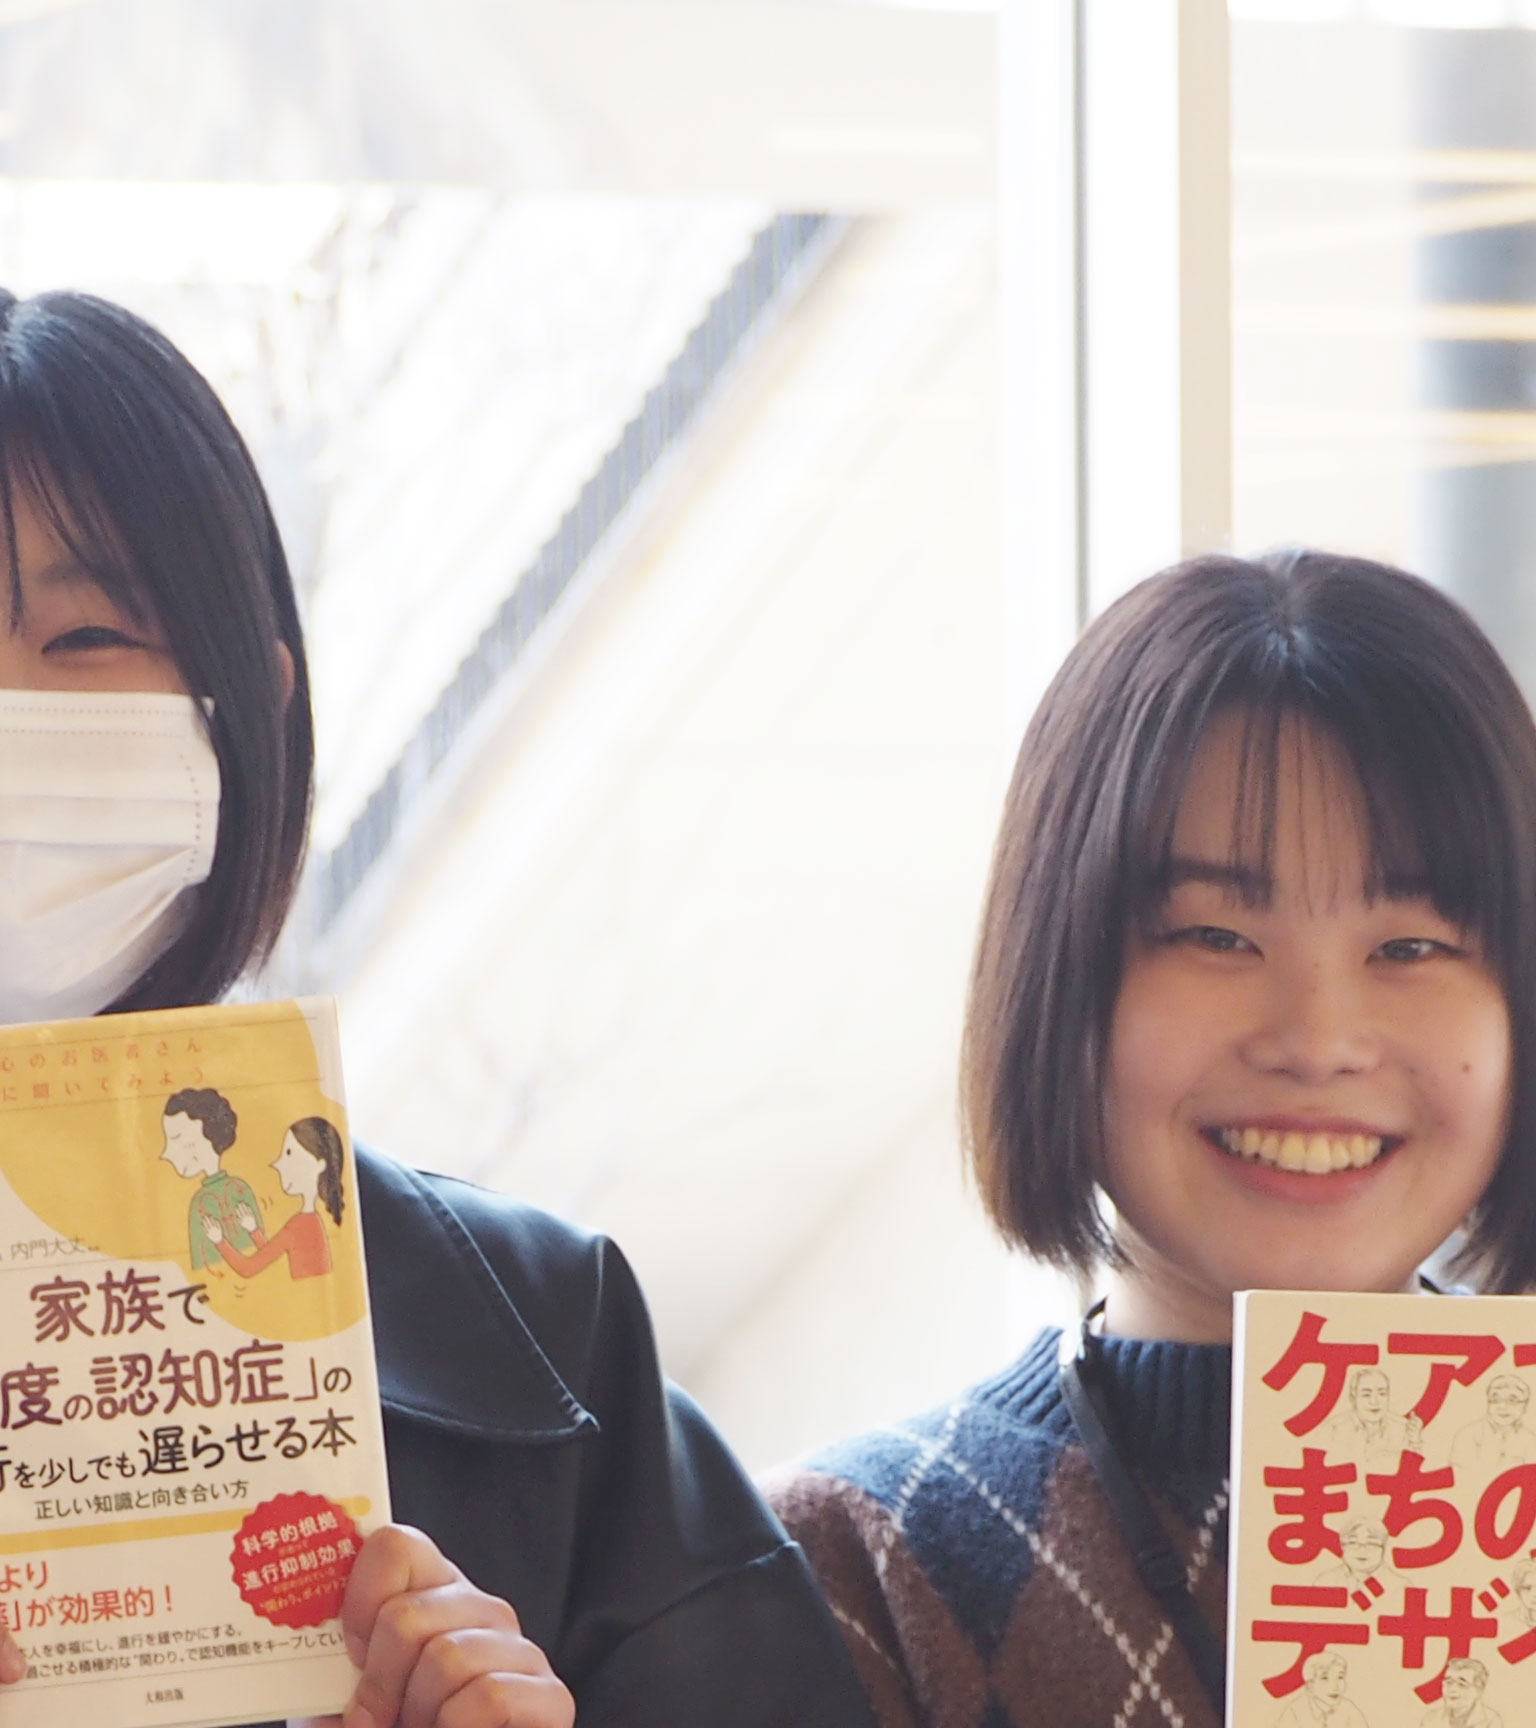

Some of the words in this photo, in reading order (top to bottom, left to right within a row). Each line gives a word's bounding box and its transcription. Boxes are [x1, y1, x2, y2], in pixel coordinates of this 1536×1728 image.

[30, 1268, 210, 1342] 家族で
[35, 1479, 249, 1520] 正しい知識と向き合い方
